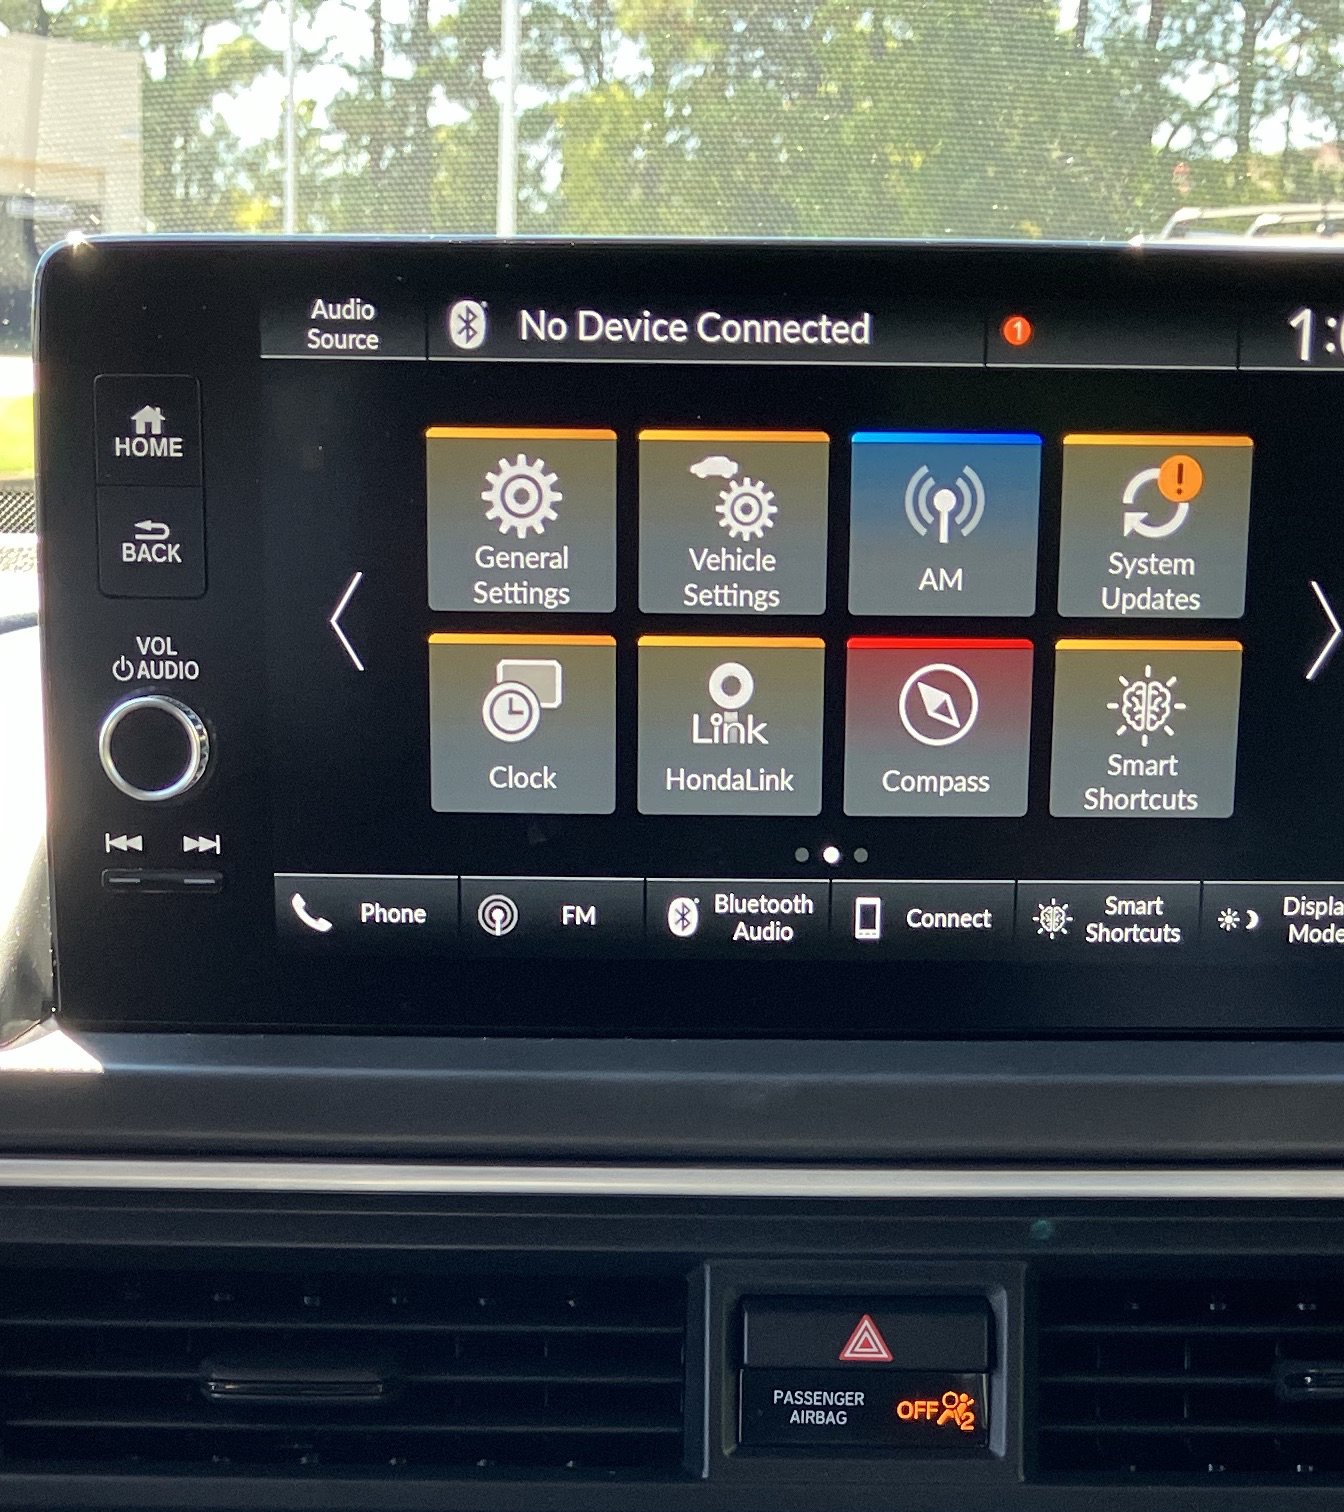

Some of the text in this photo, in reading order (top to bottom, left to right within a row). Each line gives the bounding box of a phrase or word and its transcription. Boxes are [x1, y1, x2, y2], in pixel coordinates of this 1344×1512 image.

[310, 297, 376, 321] Audio
[520, 309, 871, 345] No Device Connected
[307, 328, 380, 350] Source
[115, 436, 183, 458] HOME
[122, 542, 182, 563] BACK
[475, 545, 569, 570] General
[688, 547, 777, 572] Vehicle
[1108, 551, 1195, 580] System
[918, 567, 963, 591] AM
[473, 580, 571, 610] Settings
[683, 582, 780, 612] Settings
[1101, 586, 1201, 615] Updates
[135, 636, 178, 656] VOL
[136, 660, 200, 680] AUDIO
[1107, 753, 1179, 777] Smart
[489, 765, 557, 789] Clock
[666, 767, 794, 792] HondaLink
[882, 769, 991, 797] Compass
[1083, 786, 1199, 811] Shortcuts
[361, 902, 427, 924] Phone
[714, 892, 814, 914] Bluetooth
[1104, 895, 1164, 916] Smart
[562, 905, 596, 926] FM
[906, 908, 993, 929] Connect
[732, 920, 794, 942] Audio
[1085, 922, 1181, 943] Shortcuts
[773, 1389, 865, 1407] PASSENGER
[789, 1409, 848, 1425] AIRBAG
[896, 1400, 940, 1420] OFF
